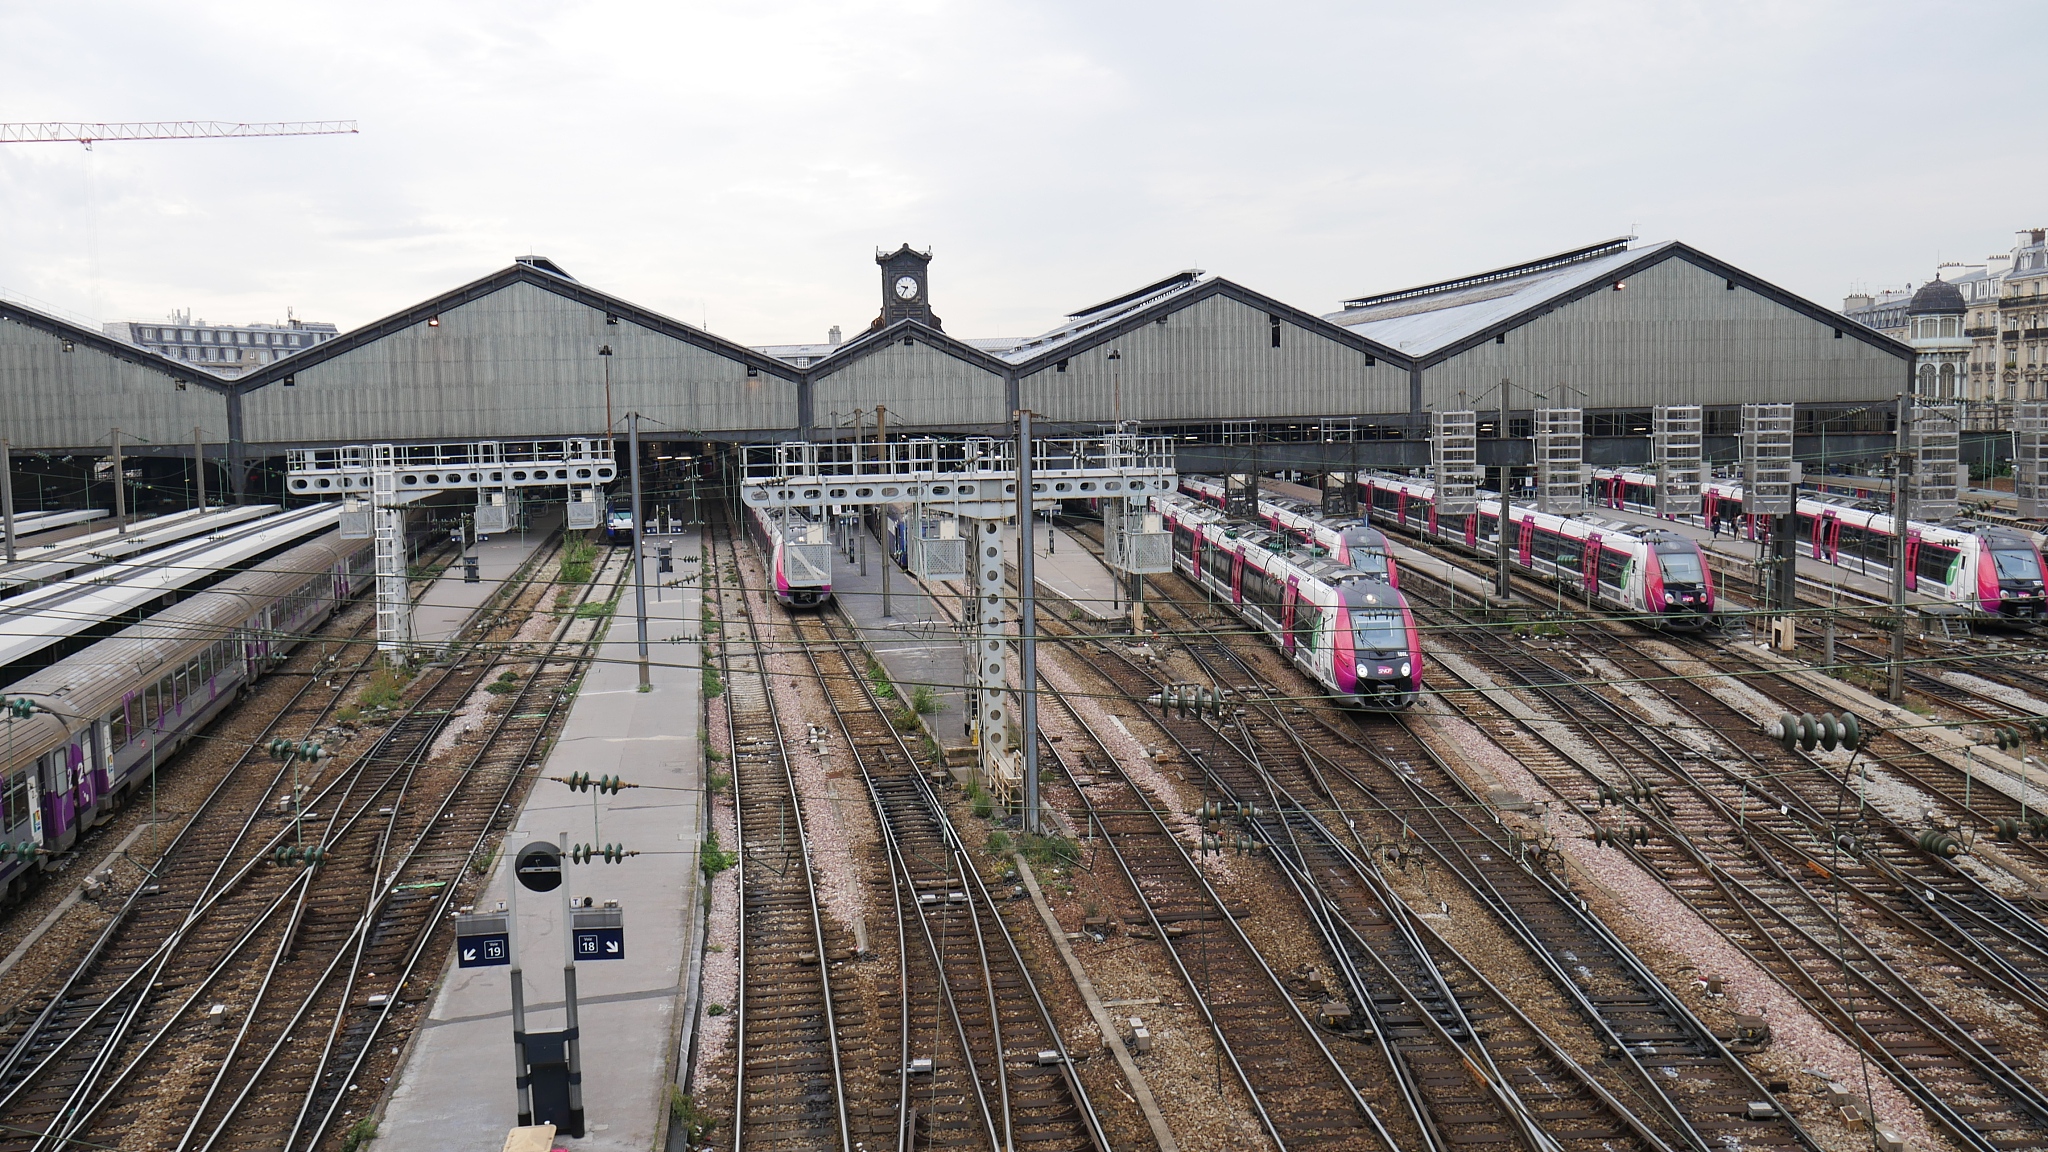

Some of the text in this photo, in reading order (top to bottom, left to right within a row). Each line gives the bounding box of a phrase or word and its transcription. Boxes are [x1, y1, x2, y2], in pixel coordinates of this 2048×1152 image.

[67, 767, 73, 790] 2
[77, 762, 85, 784] 2
[488, 947, 501, 957] 19
[582, 942, 595, 951] 18
